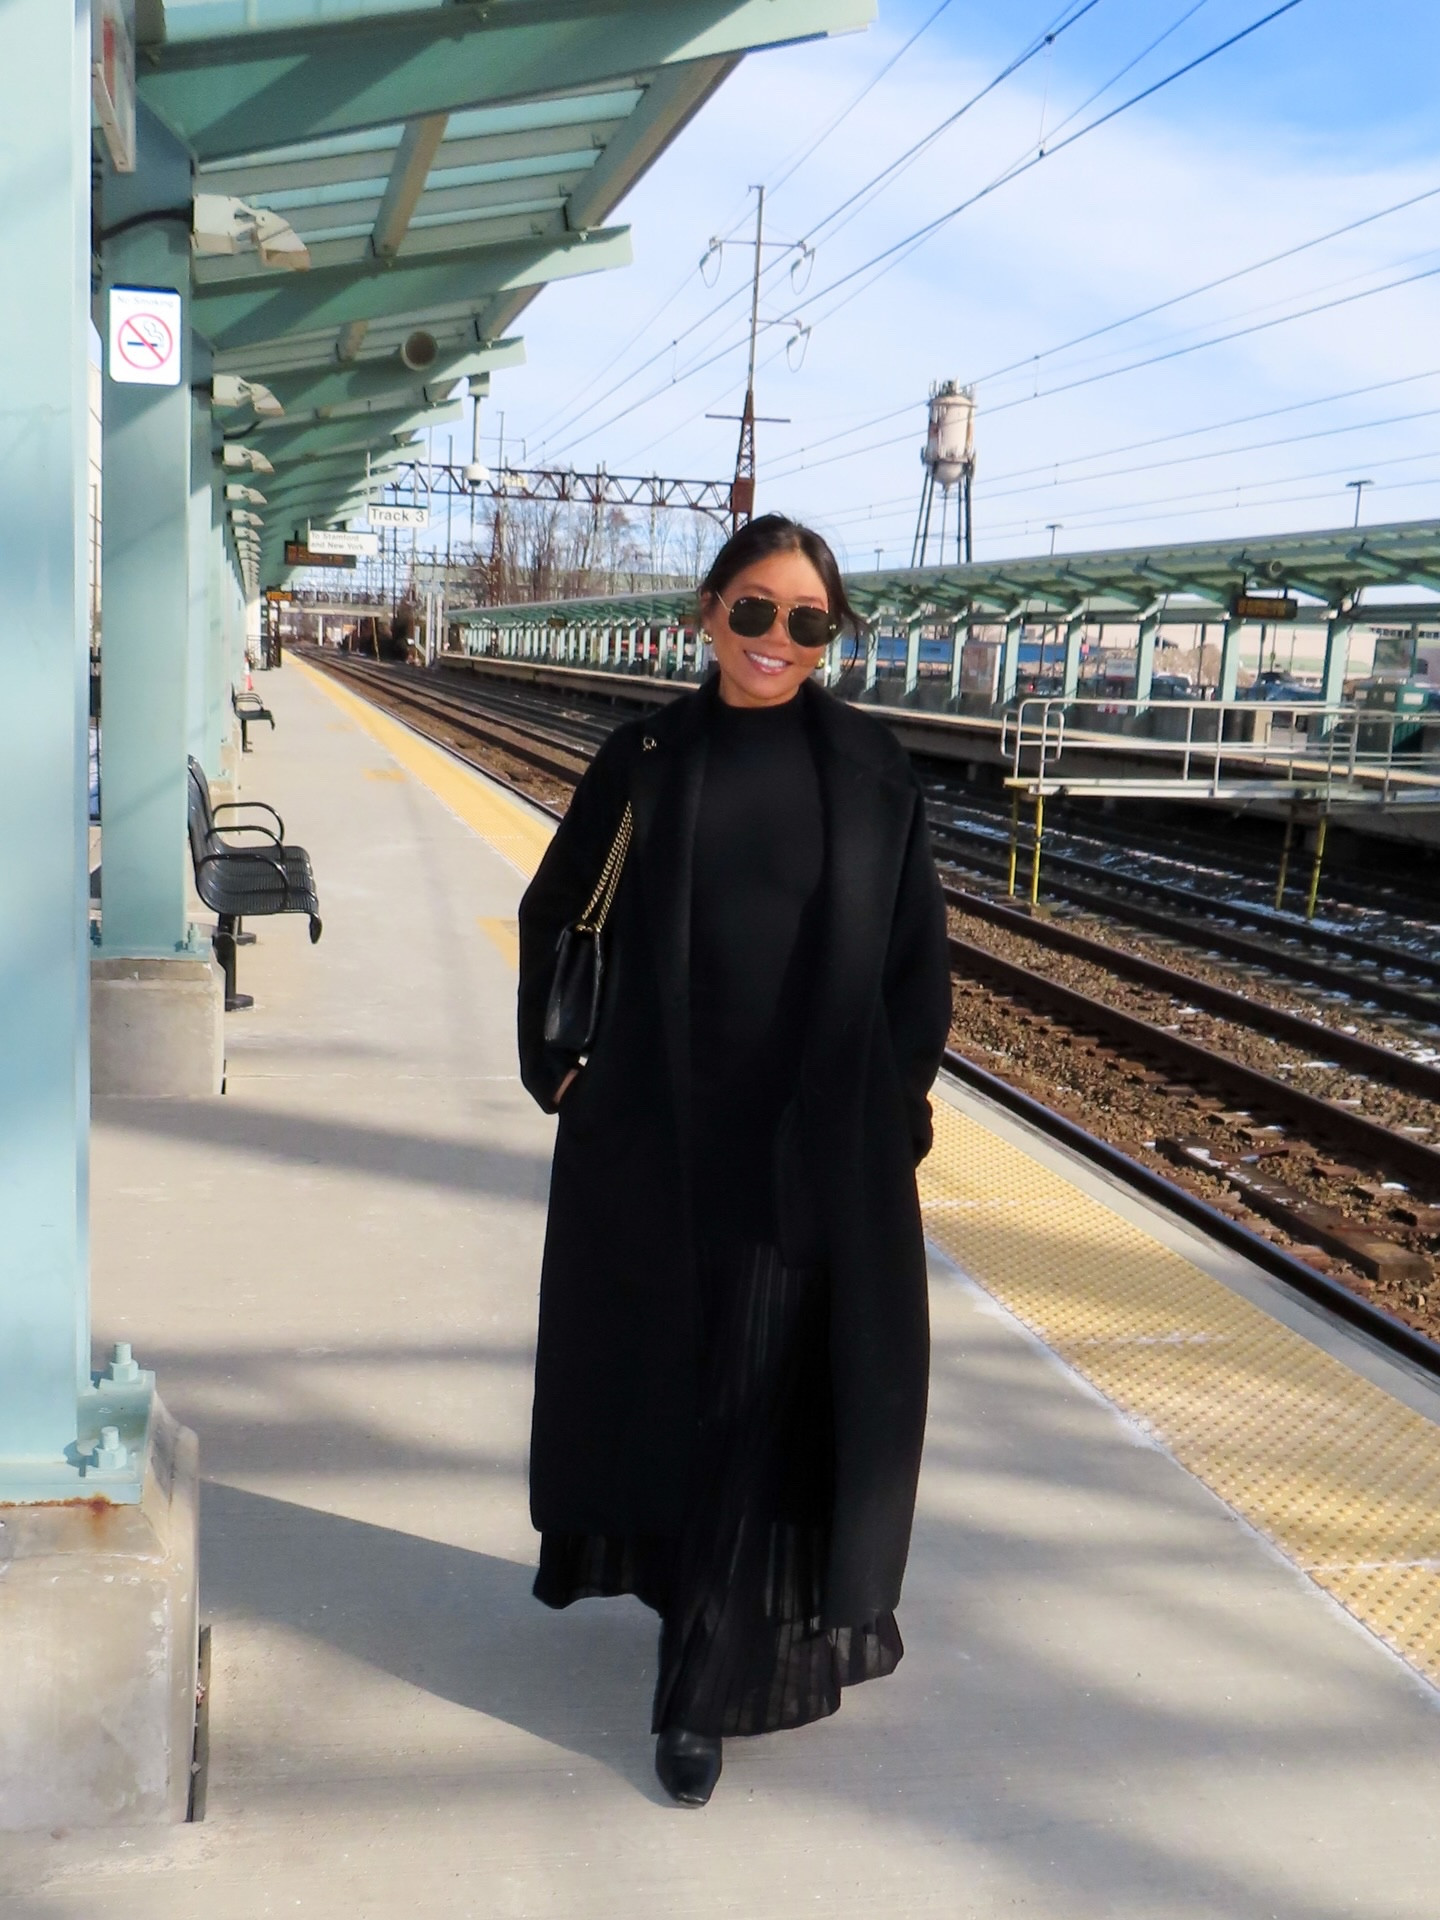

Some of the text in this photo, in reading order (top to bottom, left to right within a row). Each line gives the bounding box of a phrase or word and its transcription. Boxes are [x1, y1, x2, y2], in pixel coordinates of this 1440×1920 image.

[134, 297, 174, 308] Smoking
[371, 508, 425, 522] Track 3
[311, 532, 360, 541] To Stamford
